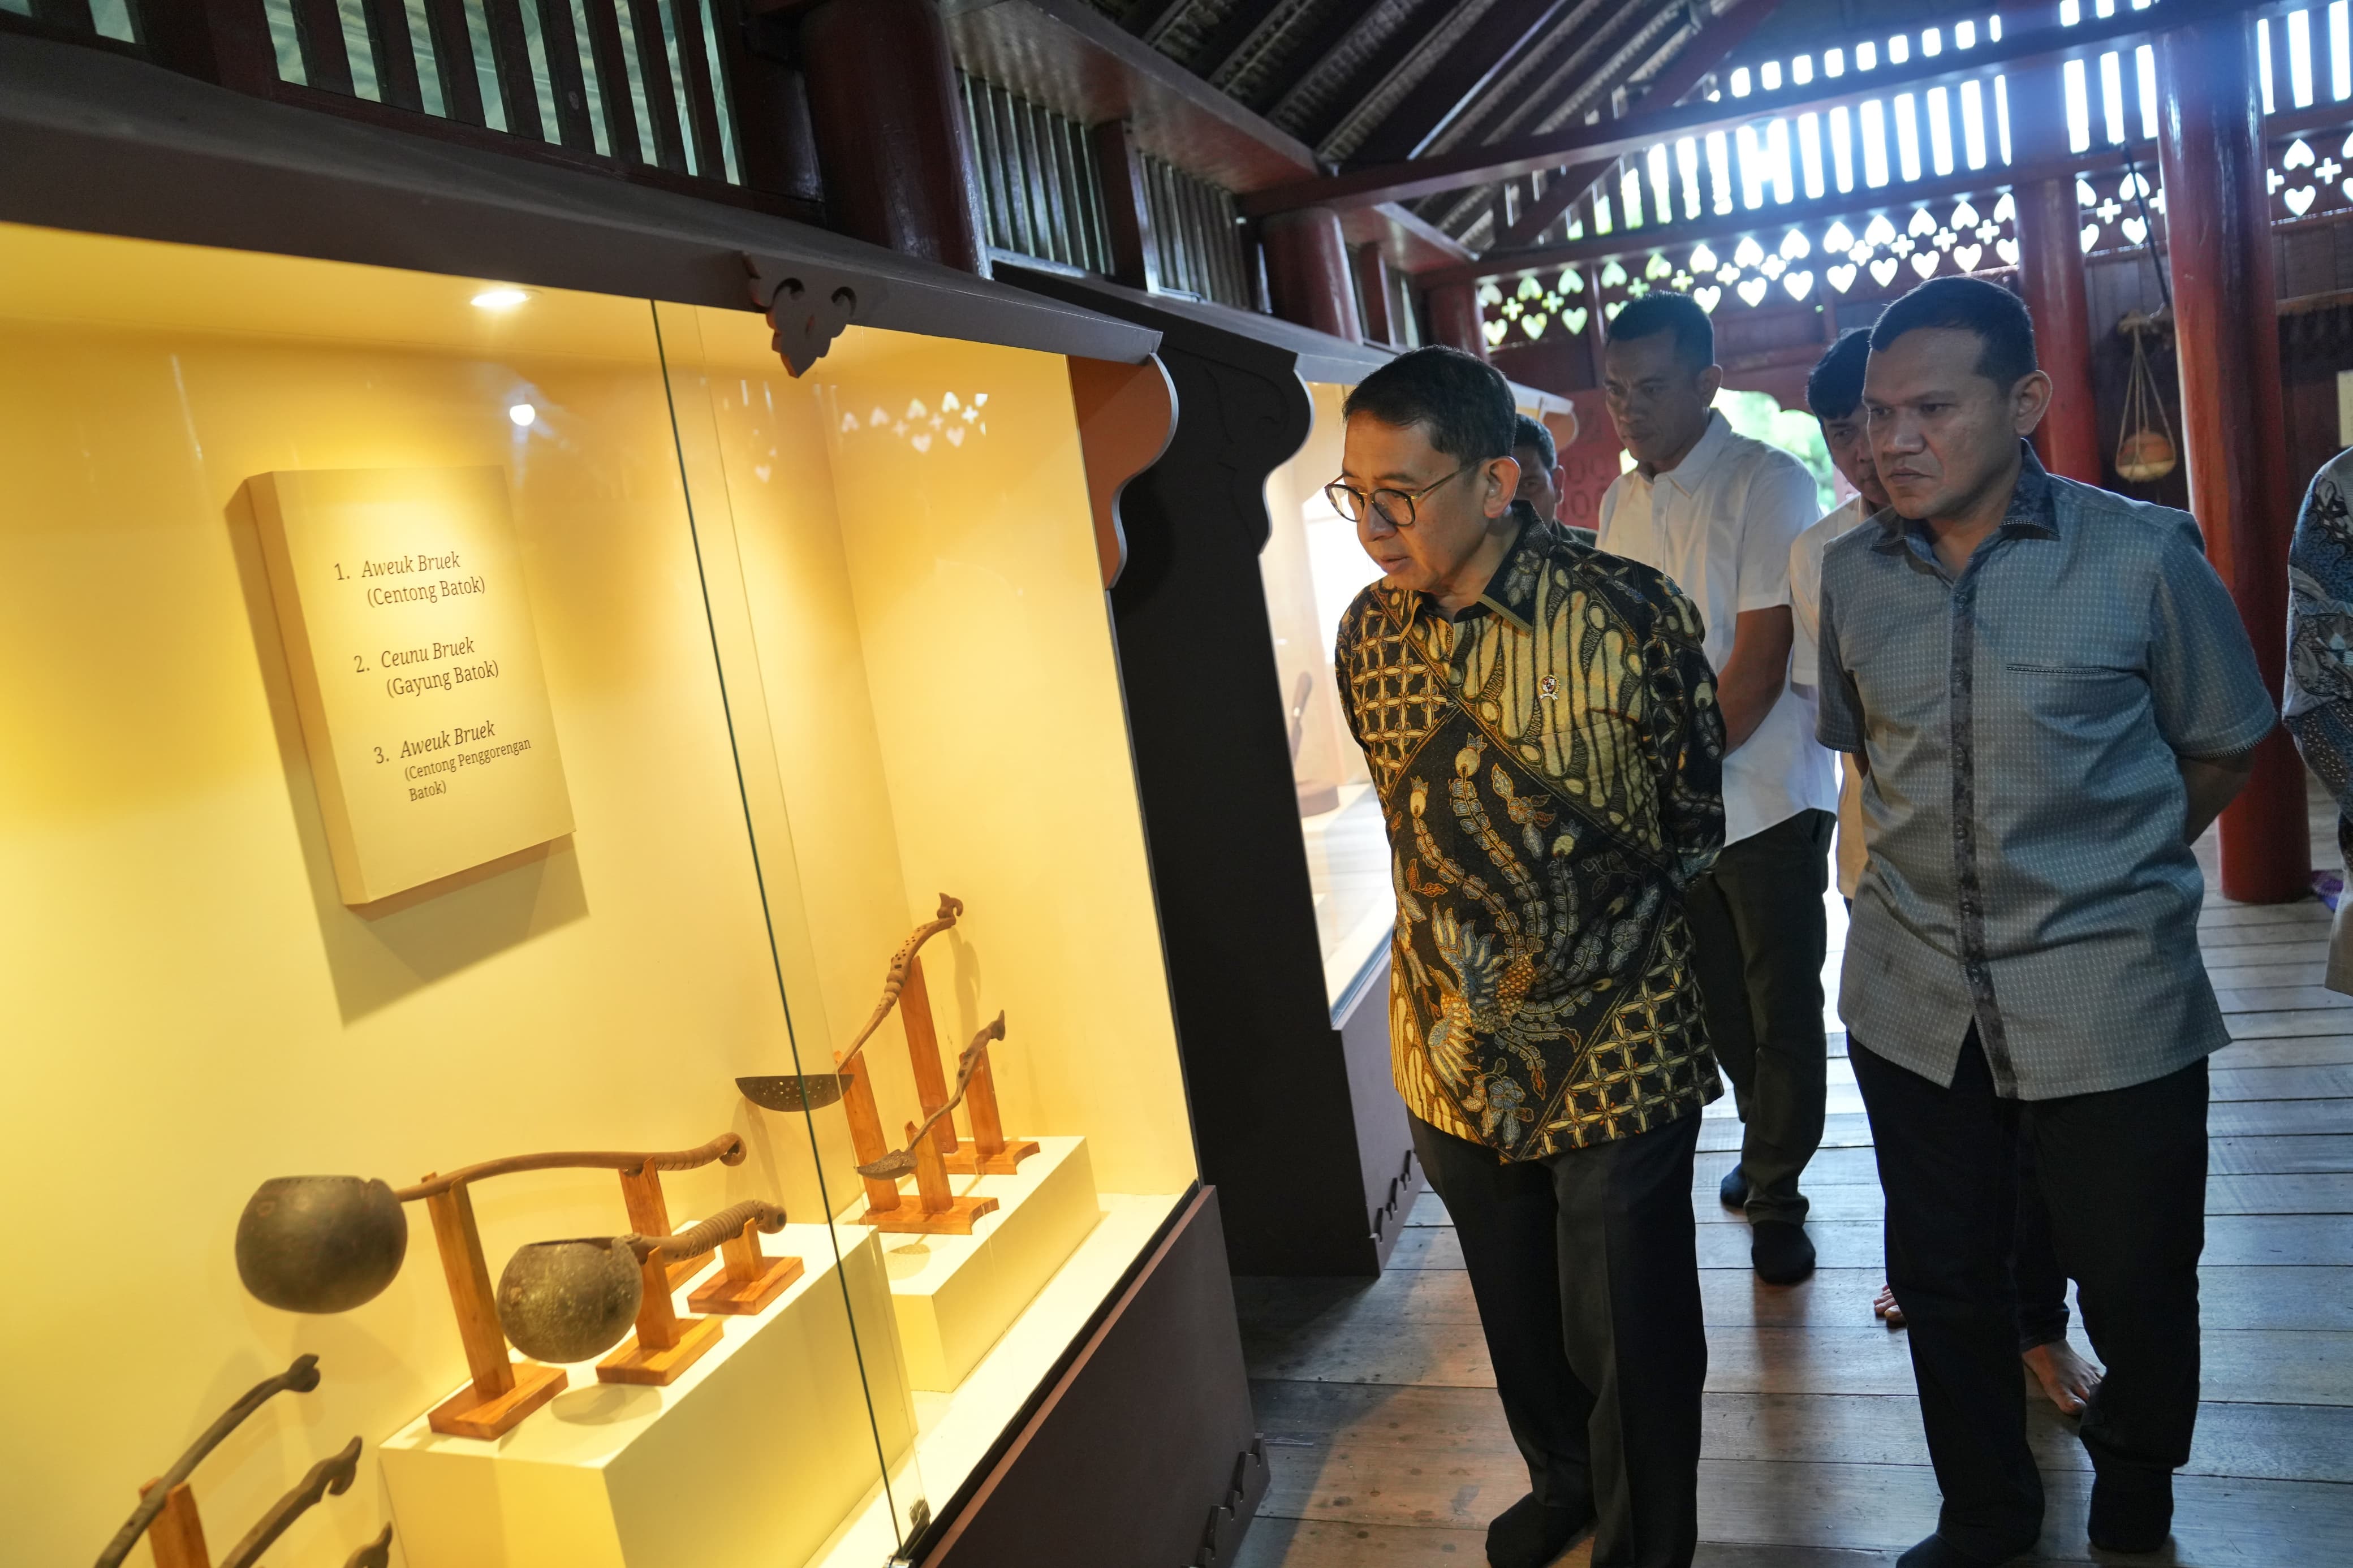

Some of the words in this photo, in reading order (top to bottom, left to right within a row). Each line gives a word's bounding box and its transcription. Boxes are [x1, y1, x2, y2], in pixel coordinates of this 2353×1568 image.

[334, 563, 350, 580] 1.
[361, 556, 414, 578] Aweuk
[418, 551, 460, 572] Bruek
[368, 585, 437, 608] (Centong
[439, 576, 485, 597] Batok)
[354, 655, 370, 673] 2.
[381, 647, 429, 668] Ceunu
[433, 637, 475, 659] Bruek
[387, 672, 452, 698] (Gayung
[453, 660, 499, 684] Batok)
[374, 746, 389, 763] 3.
[400, 731, 451, 758] Aweuk
[454, 720, 495, 745] Bruek
[405, 758, 456, 781] (Centong
[458, 739, 532, 767] Penggorengan
[409, 780, 447, 802] Batok)
